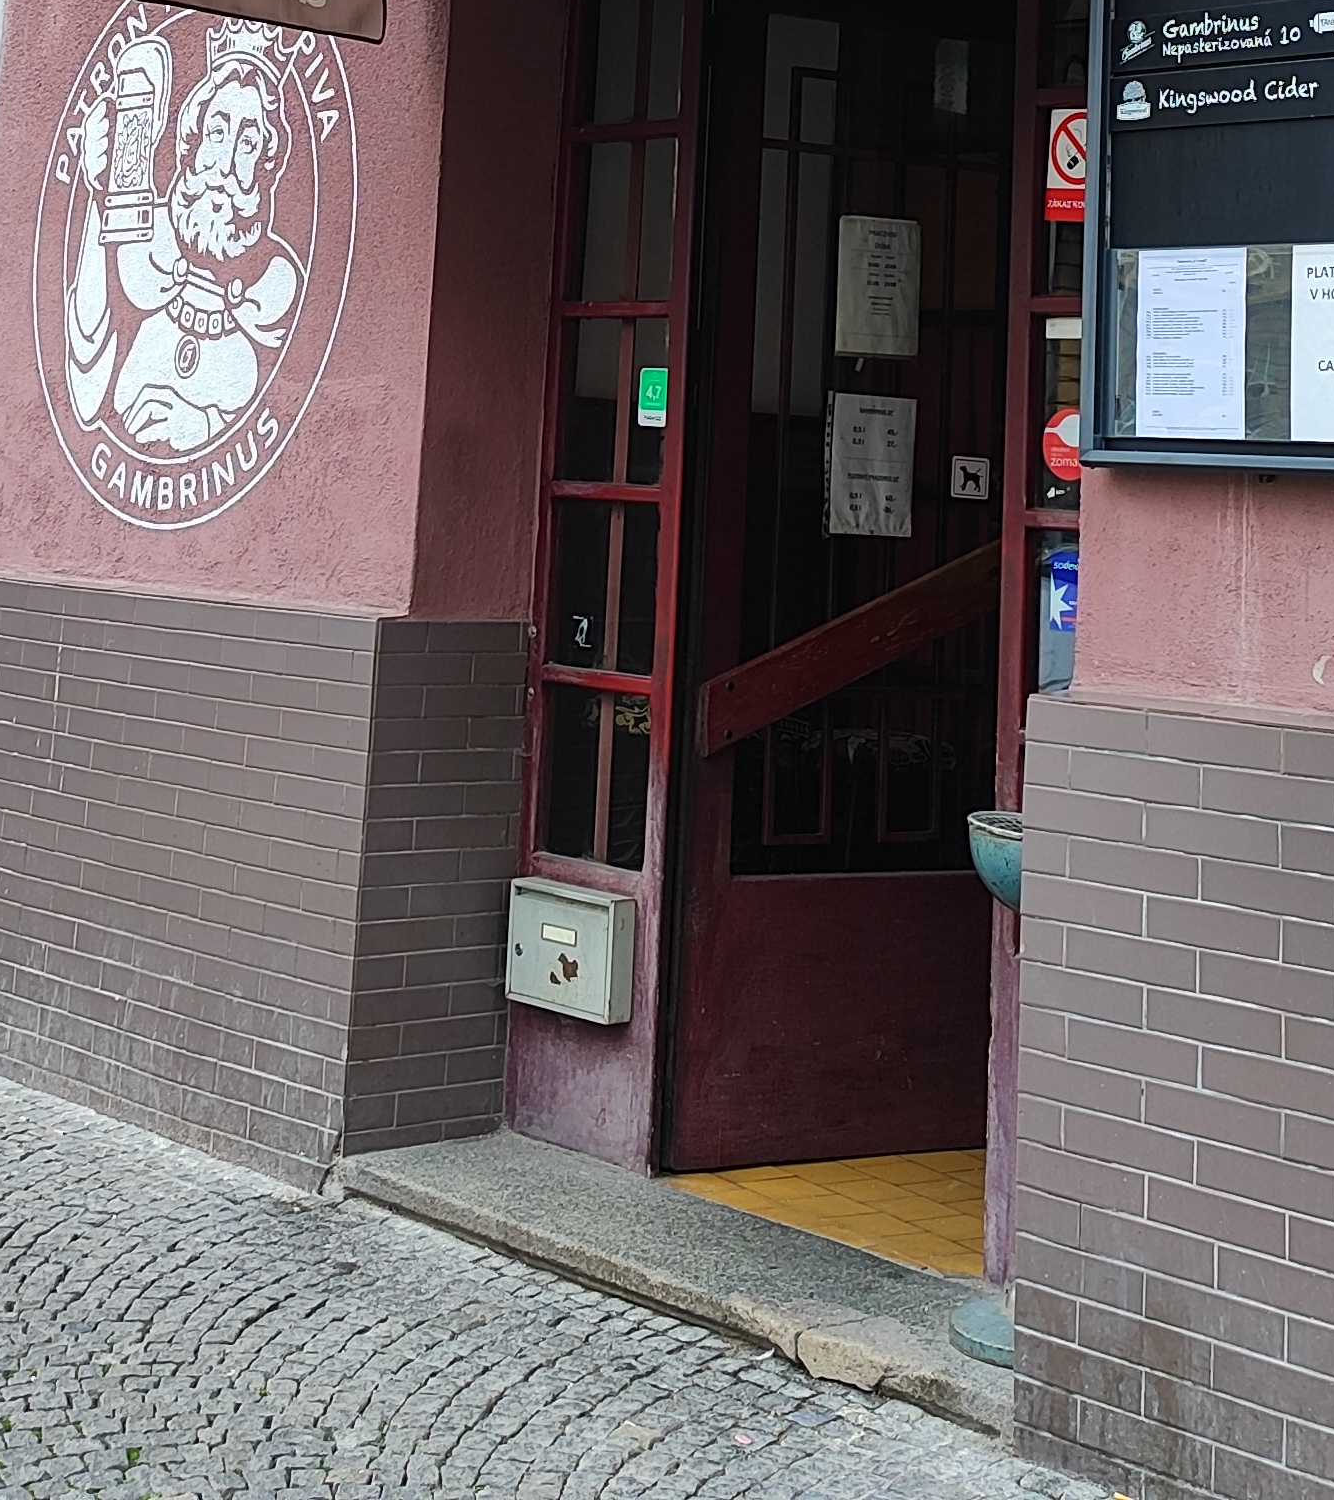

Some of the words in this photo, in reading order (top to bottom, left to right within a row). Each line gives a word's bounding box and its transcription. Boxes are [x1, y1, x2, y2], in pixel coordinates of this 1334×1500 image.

[1162, 12, 1260, 39] Gambrinus
[1162, 28, 1273, 64] Nepasterizovaná
[1279, 25, 1302, 45] 10
[1158, 78, 1258, 114] Kingswood
[1264, 75, 1319, 101] Cider
[1309, 288, 1319, 300] V
[91, 408, 280, 512] GAMBRINUS
